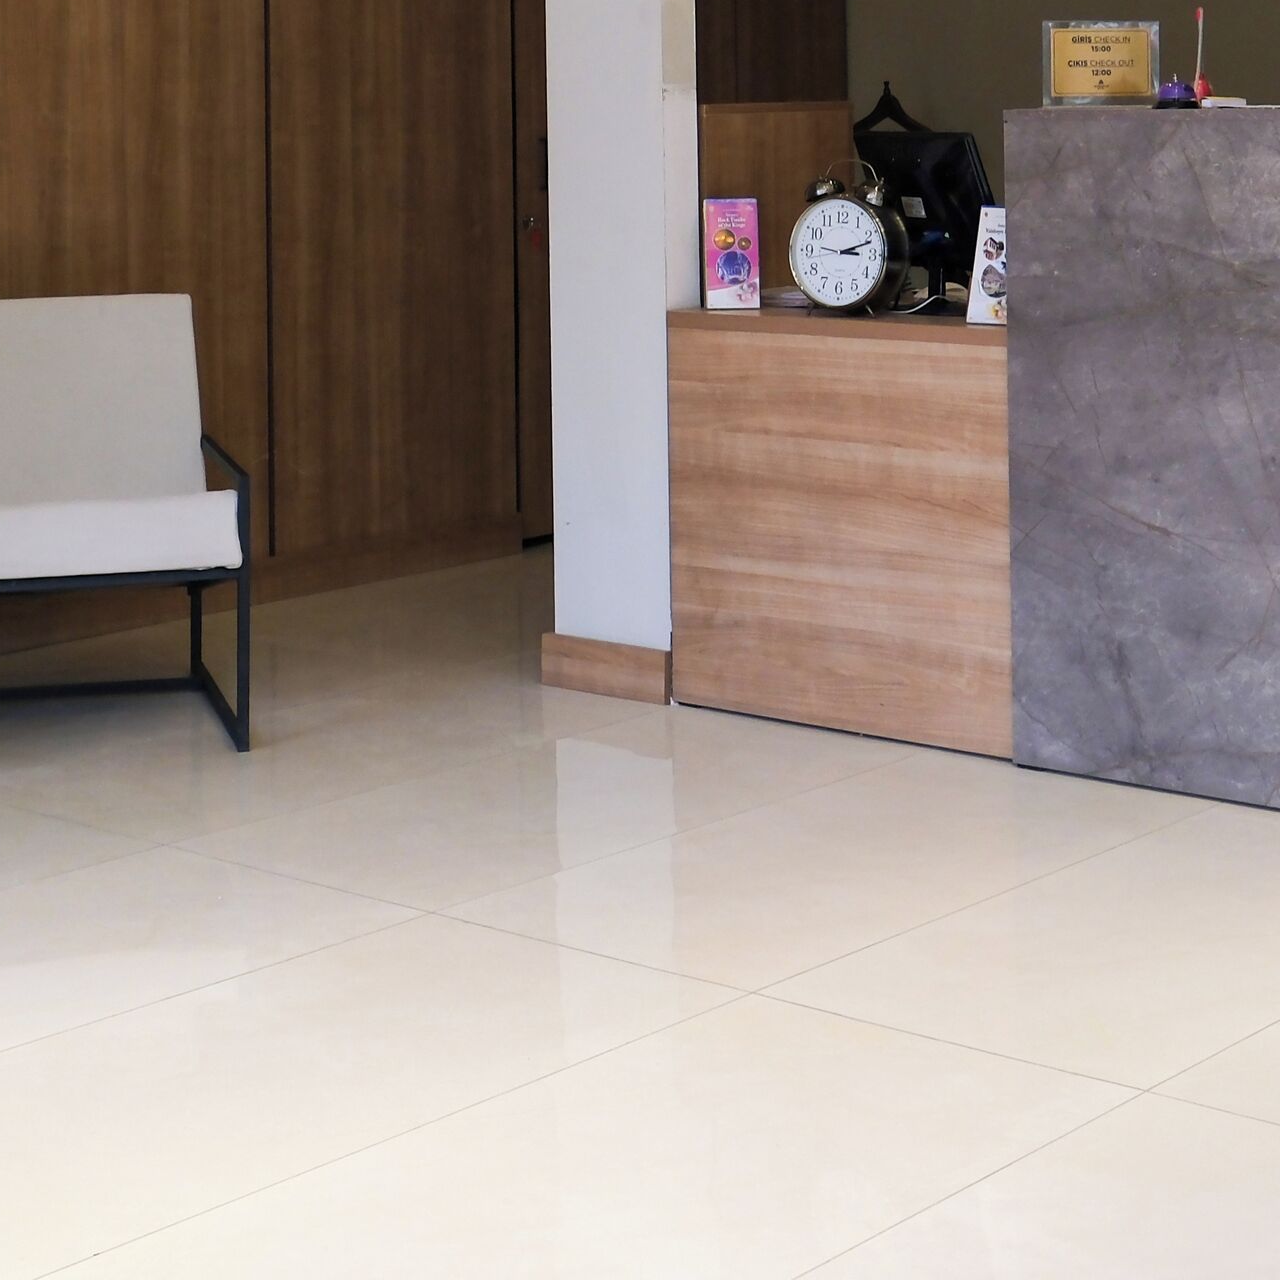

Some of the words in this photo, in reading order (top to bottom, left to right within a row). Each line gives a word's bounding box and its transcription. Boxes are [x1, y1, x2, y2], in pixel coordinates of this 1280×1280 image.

[1094, 36, 1120, 44] CHECK
[1122, 36, 1131, 44] IN
[1089, 59, 1117, 67] CHECK
[1118, 59, 1134, 67] OUT
[822, 215, 832, 227] 11
[837, 211, 849, 224] 12
[856, 216, 860, 228] 1
[811, 227, 823, 240] 10
[865, 230, 872, 242] 2
[805, 244, 814, 257] 9
[869, 248, 877, 261] 3
[809, 262, 818, 276] 8
[862, 266, 869, 278] 4
[820, 276, 828, 289] 7
[834, 281, 843, 295] 6
[850, 278, 858, 291] 5
